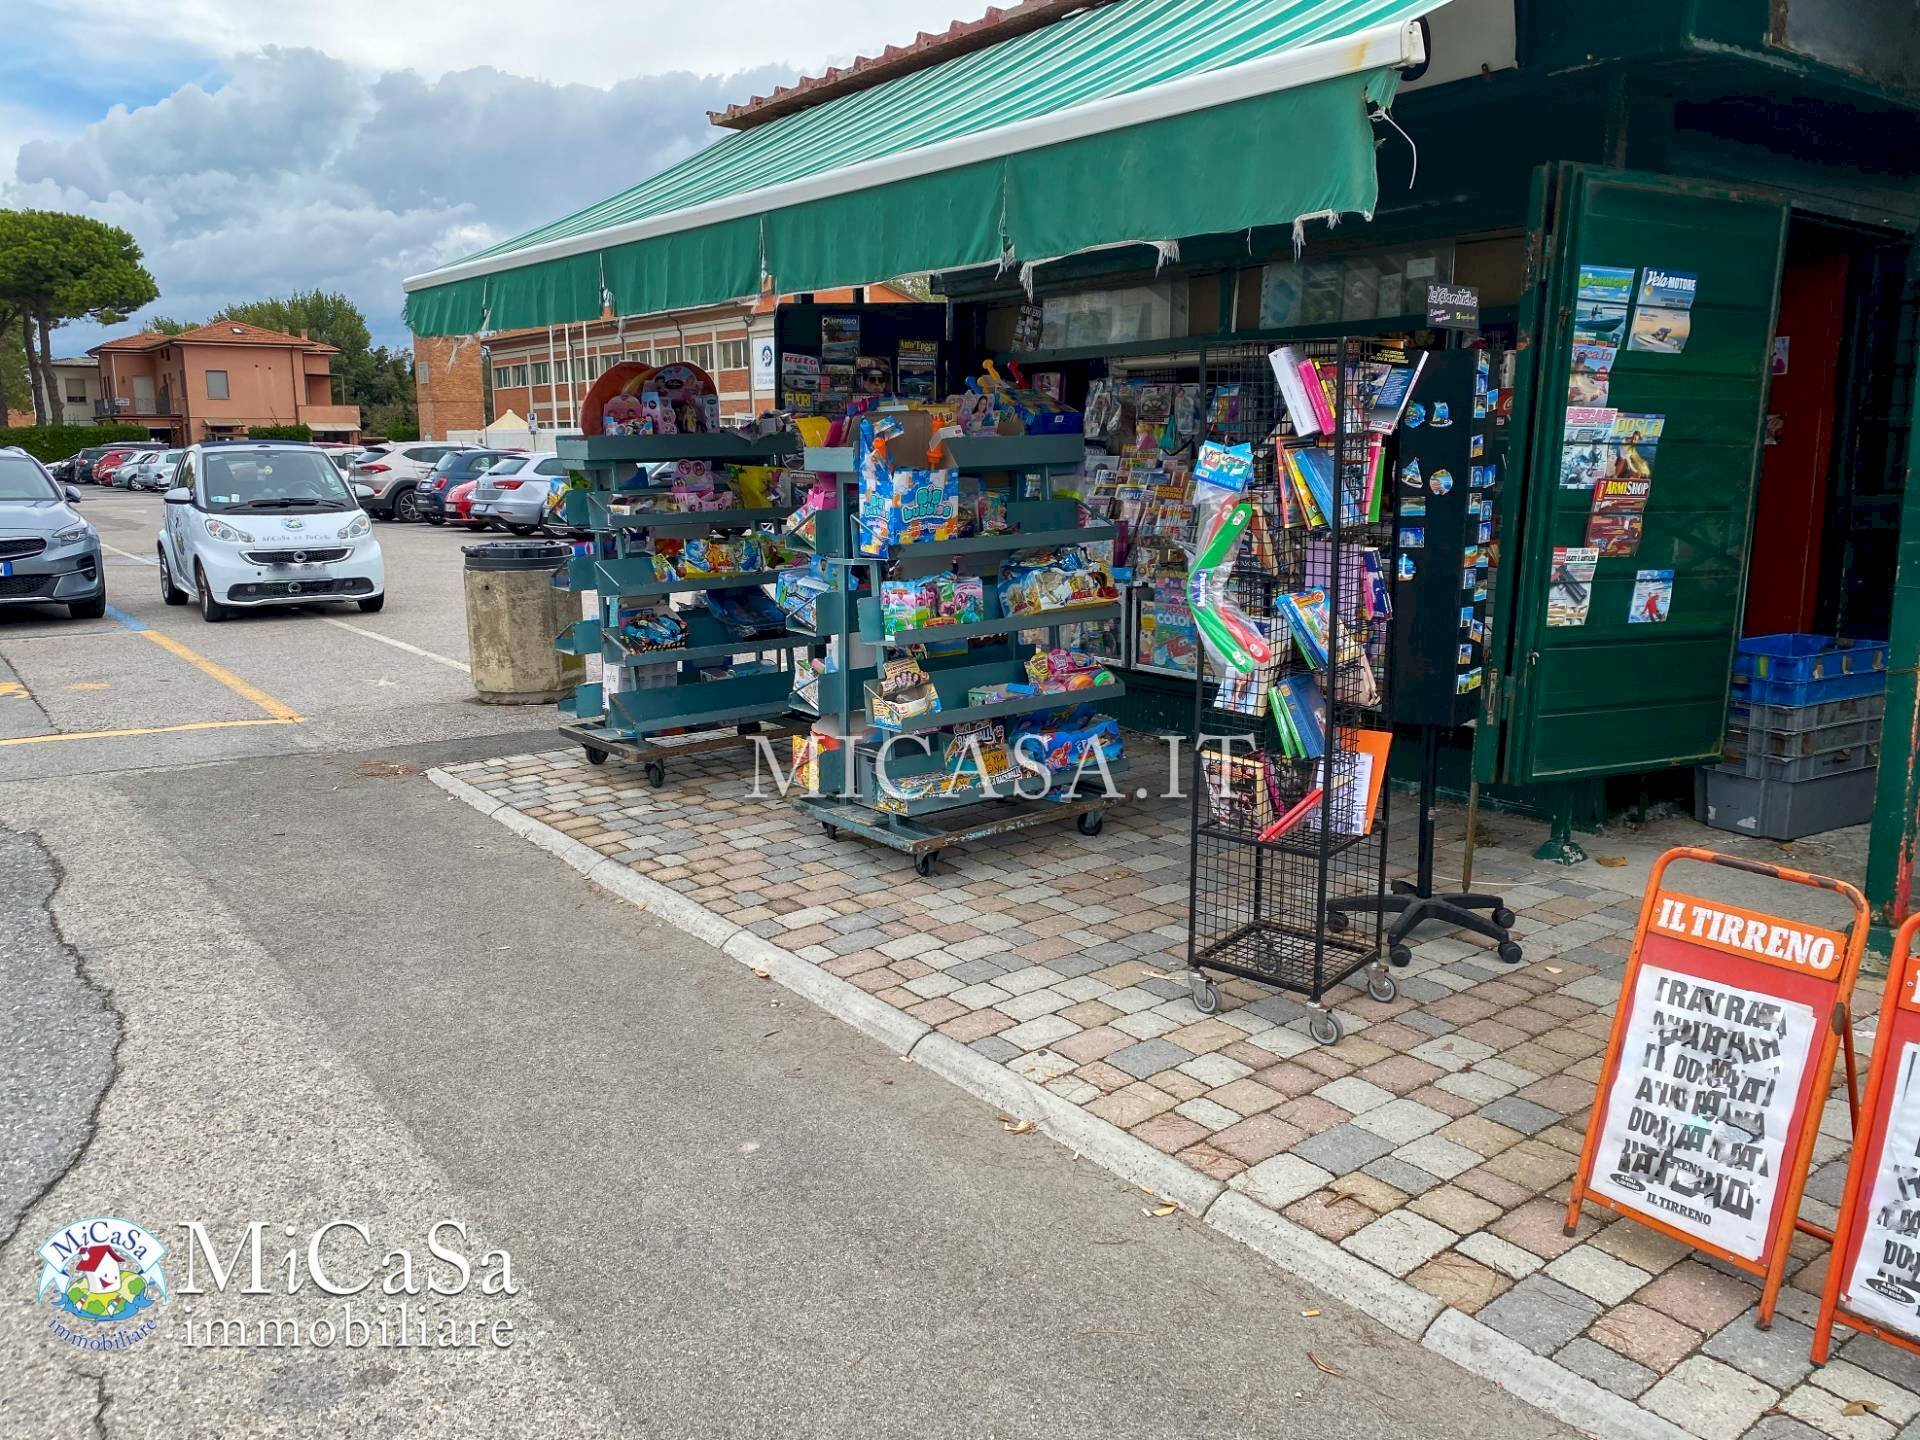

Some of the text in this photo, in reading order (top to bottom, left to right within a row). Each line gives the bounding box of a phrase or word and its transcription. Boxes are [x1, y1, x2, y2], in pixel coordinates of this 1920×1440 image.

[1657, 898, 1836, 970] IL TIRRENO
[1647, 1191, 1712, 1225] IL TIRRENO
